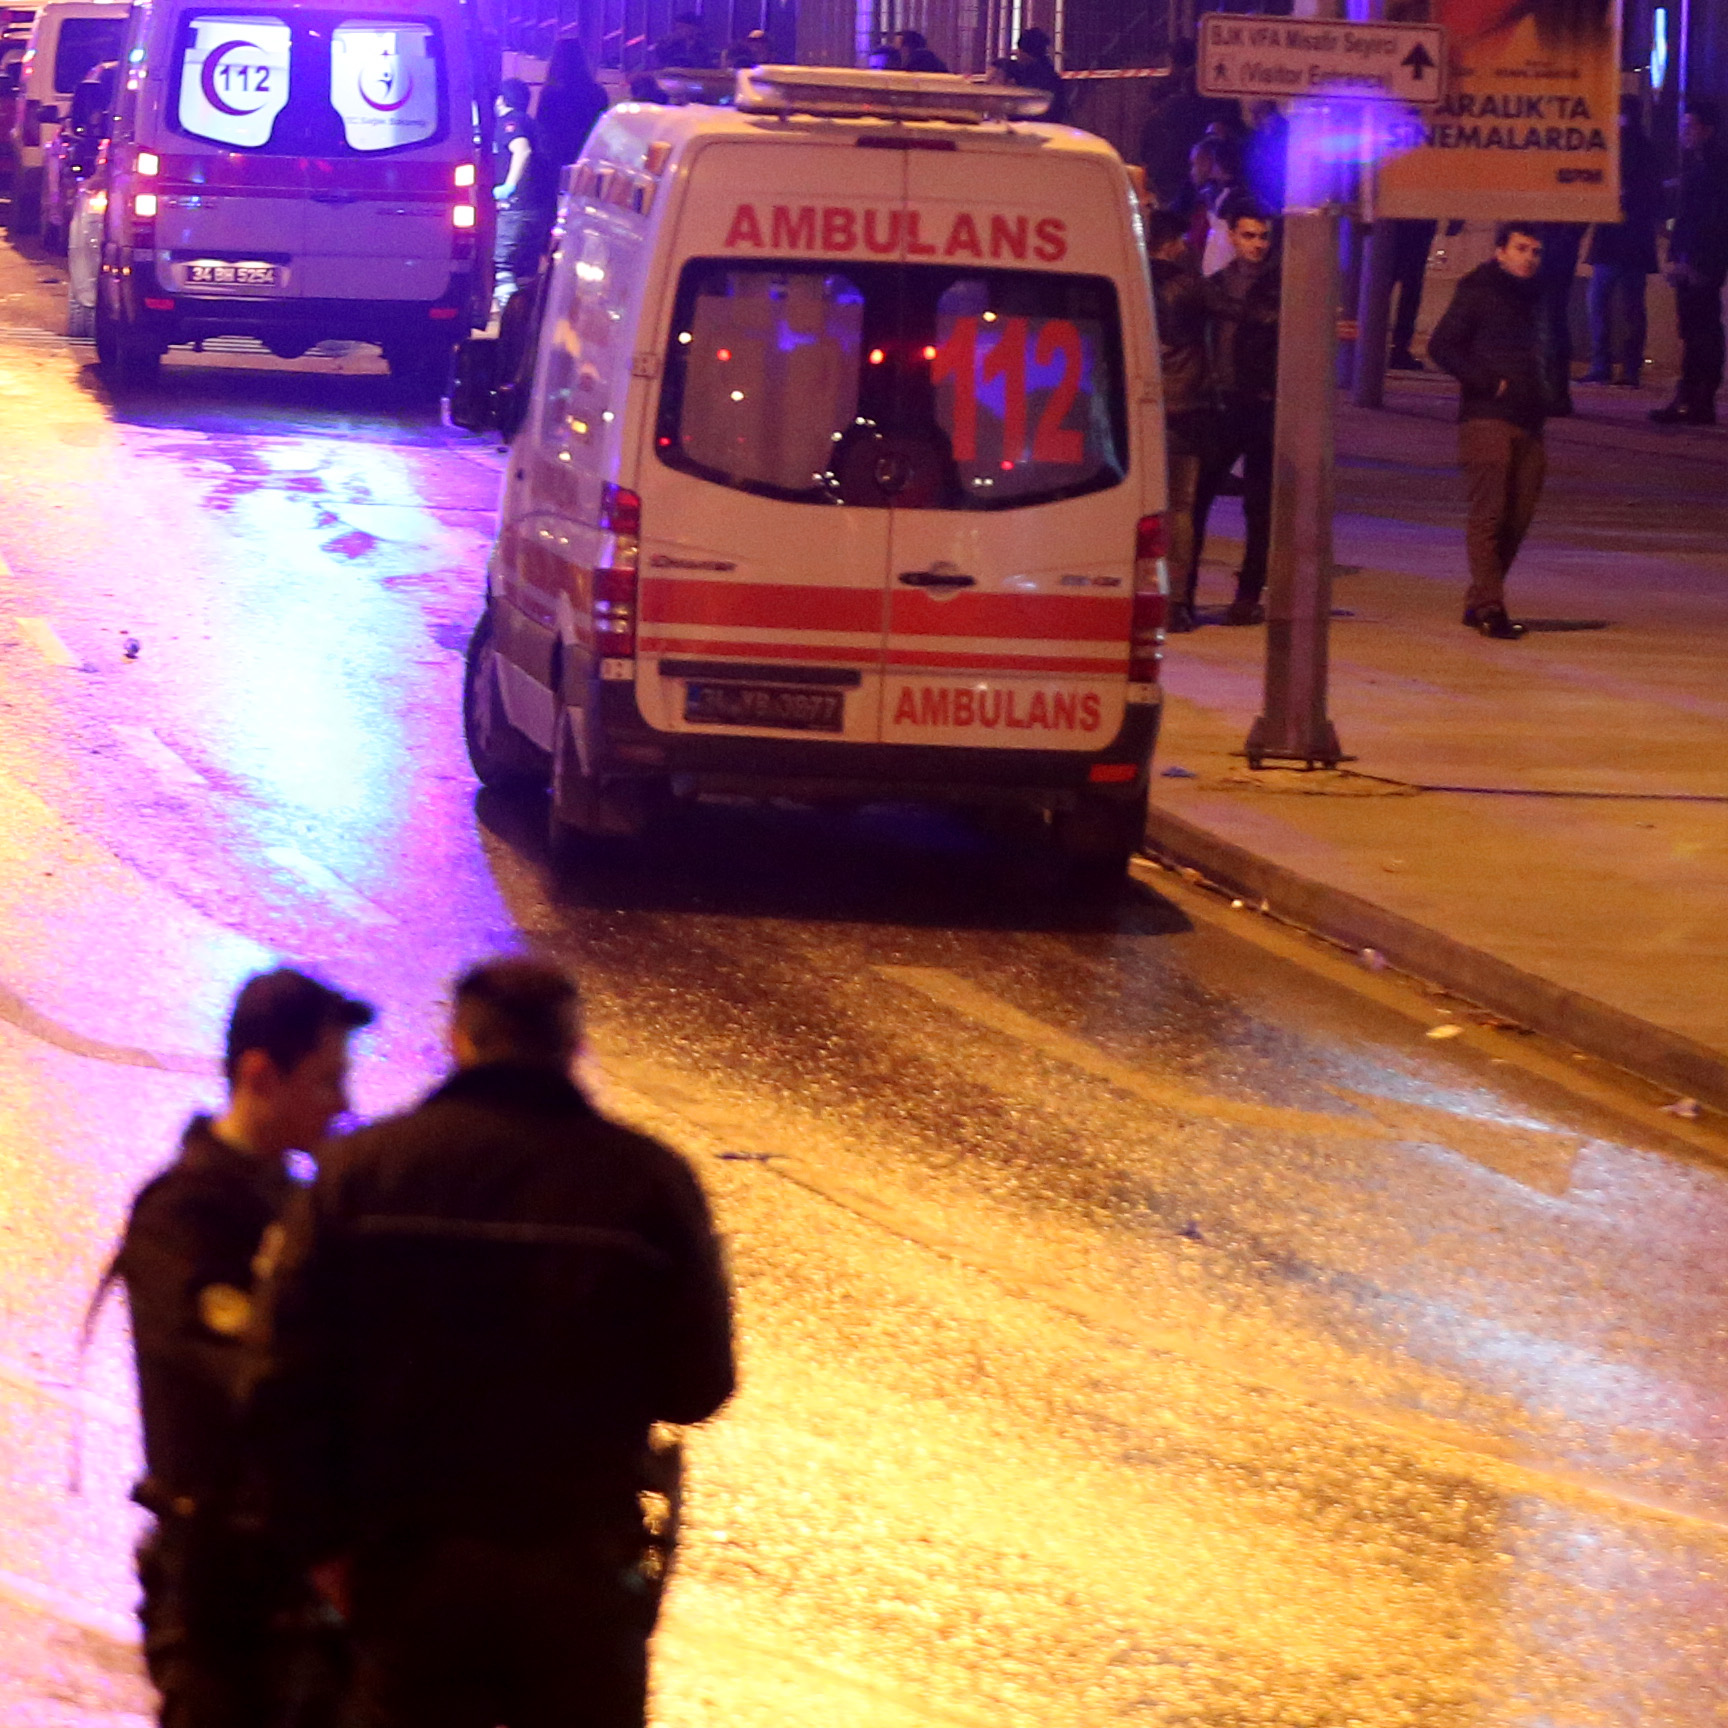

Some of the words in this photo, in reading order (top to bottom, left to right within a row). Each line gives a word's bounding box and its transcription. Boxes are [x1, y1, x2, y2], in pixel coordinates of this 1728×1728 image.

[218, 65, 270, 93] 112
[724, 203, 1069, 262] AMBULANS
[930, 315, 1085, 463] 112
[894, 685, 1103, 732] AMBULANS
